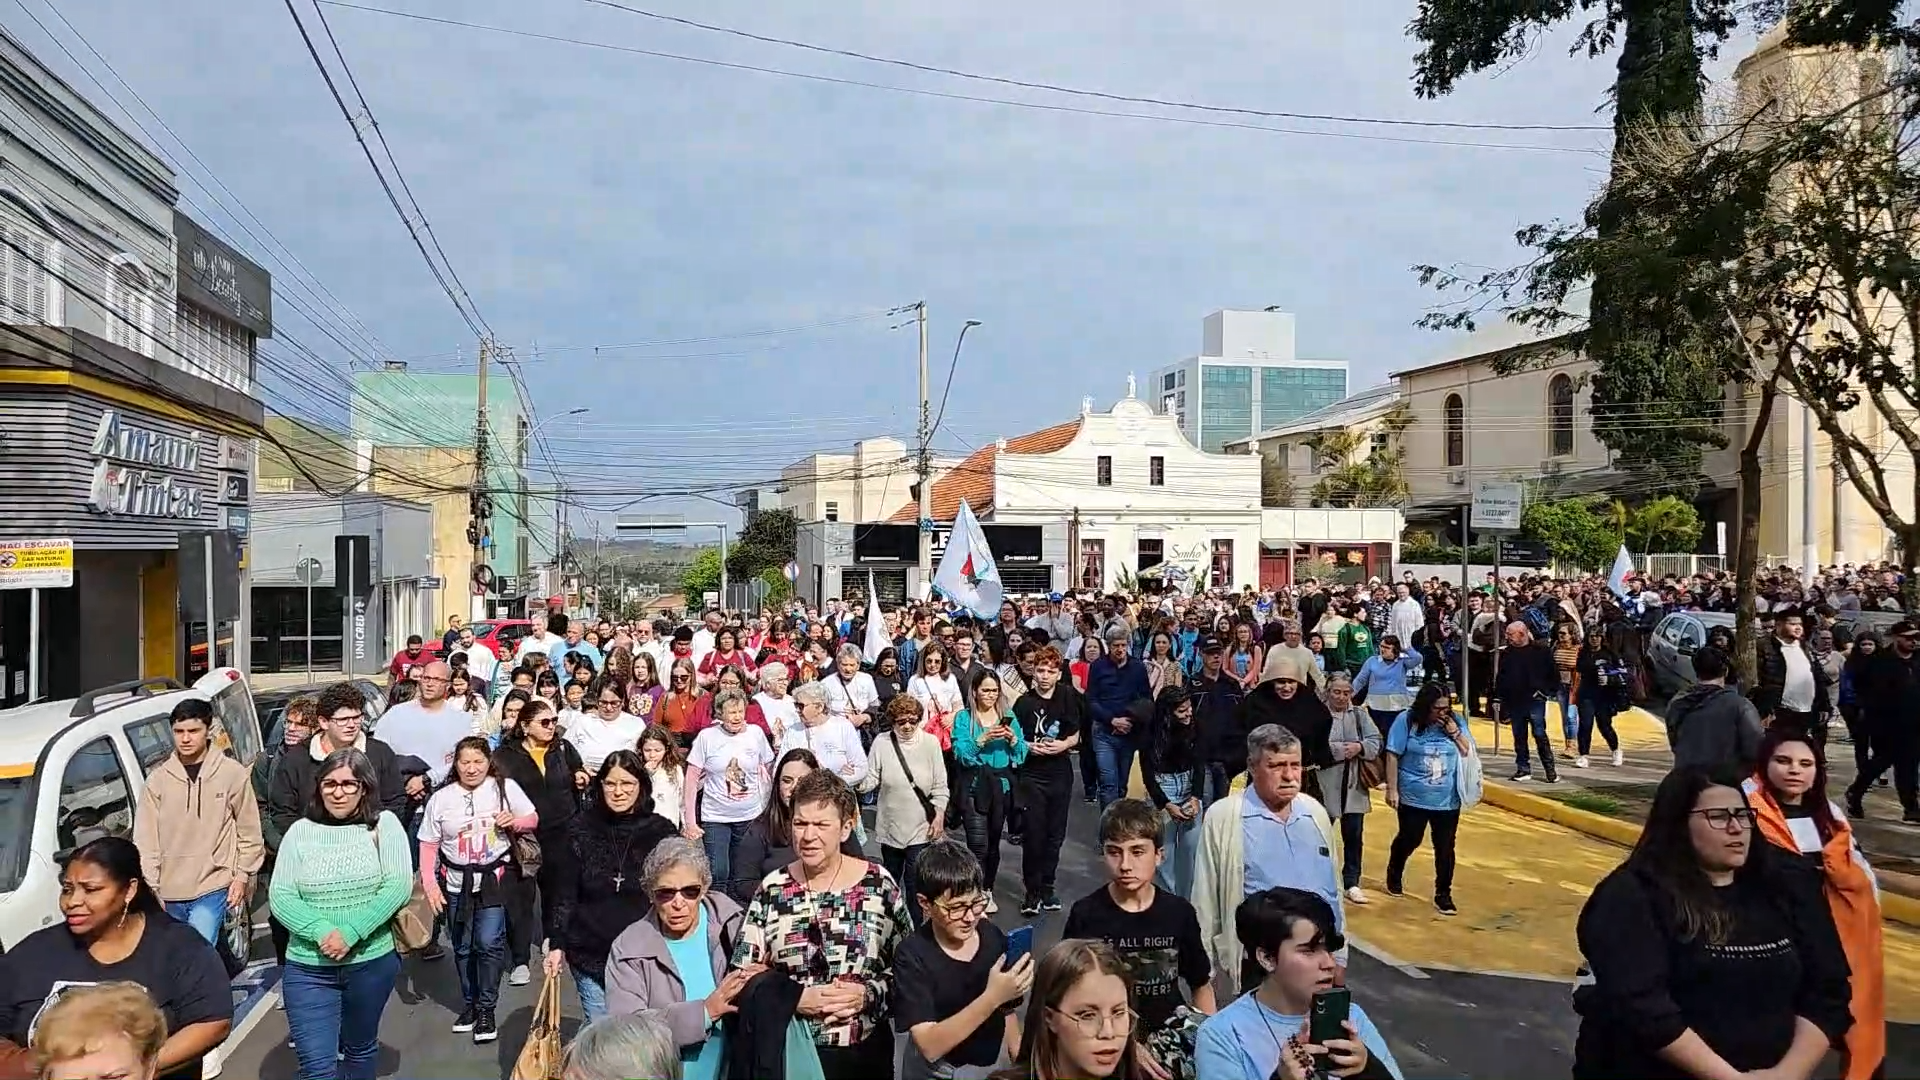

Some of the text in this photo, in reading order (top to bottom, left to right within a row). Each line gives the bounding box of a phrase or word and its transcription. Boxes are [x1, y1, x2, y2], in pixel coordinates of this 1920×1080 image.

[118, 467, 203, 518] Tintas
[24, 540, 70, 549] ESCAVAR
[1169, 542, 1201, 559] Sonho
[355, 614, 365, 660] UNICRED
[1119, 937, 1140, 948] ALL
[1144, 936, 1175, 947] RIGHT
